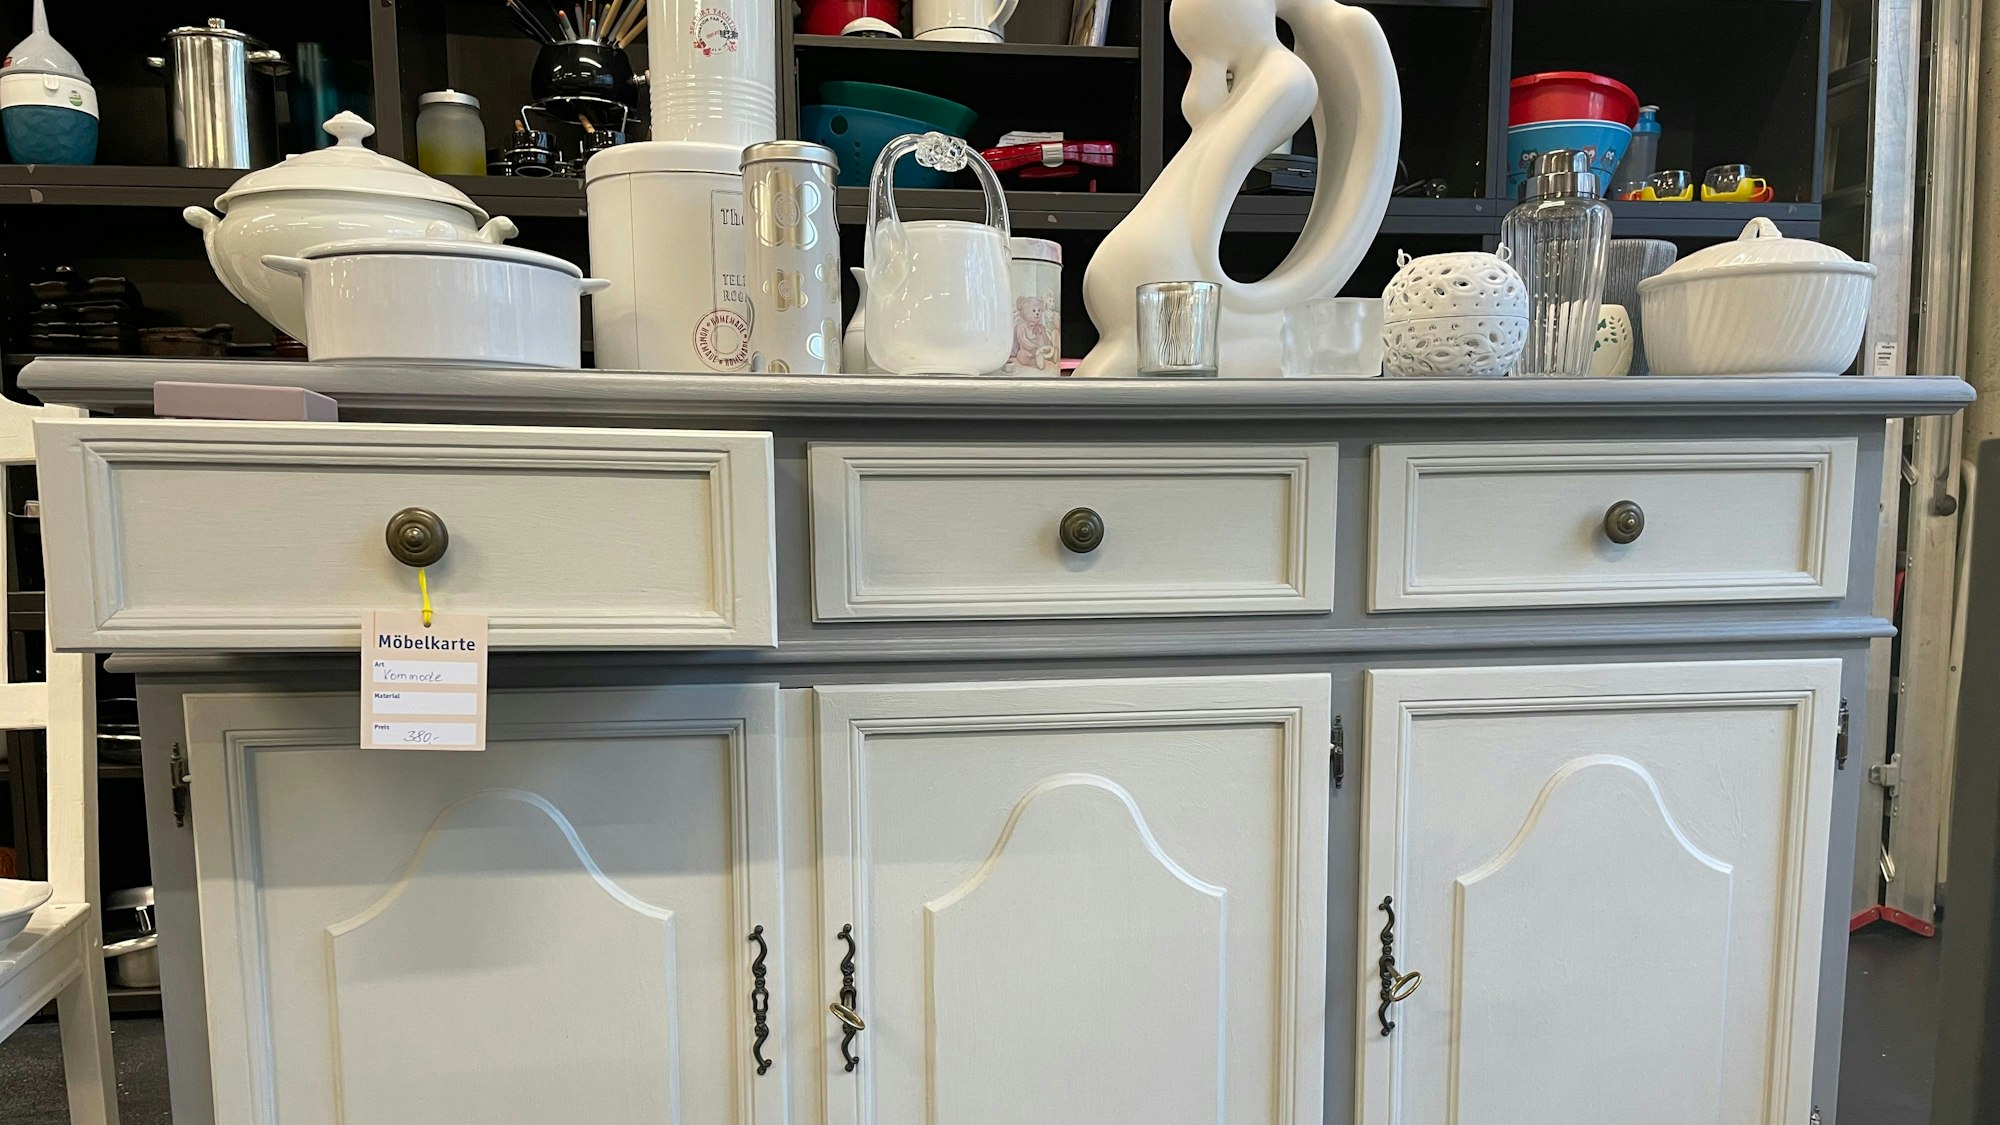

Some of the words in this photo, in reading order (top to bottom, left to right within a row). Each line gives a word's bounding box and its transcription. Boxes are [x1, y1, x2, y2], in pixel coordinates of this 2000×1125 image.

[710, 315, 746, 334] HOMEMADE
[700, 327, 717, 363] HOMEMADE
[378, 634, 476, 651] Möbelkarte
